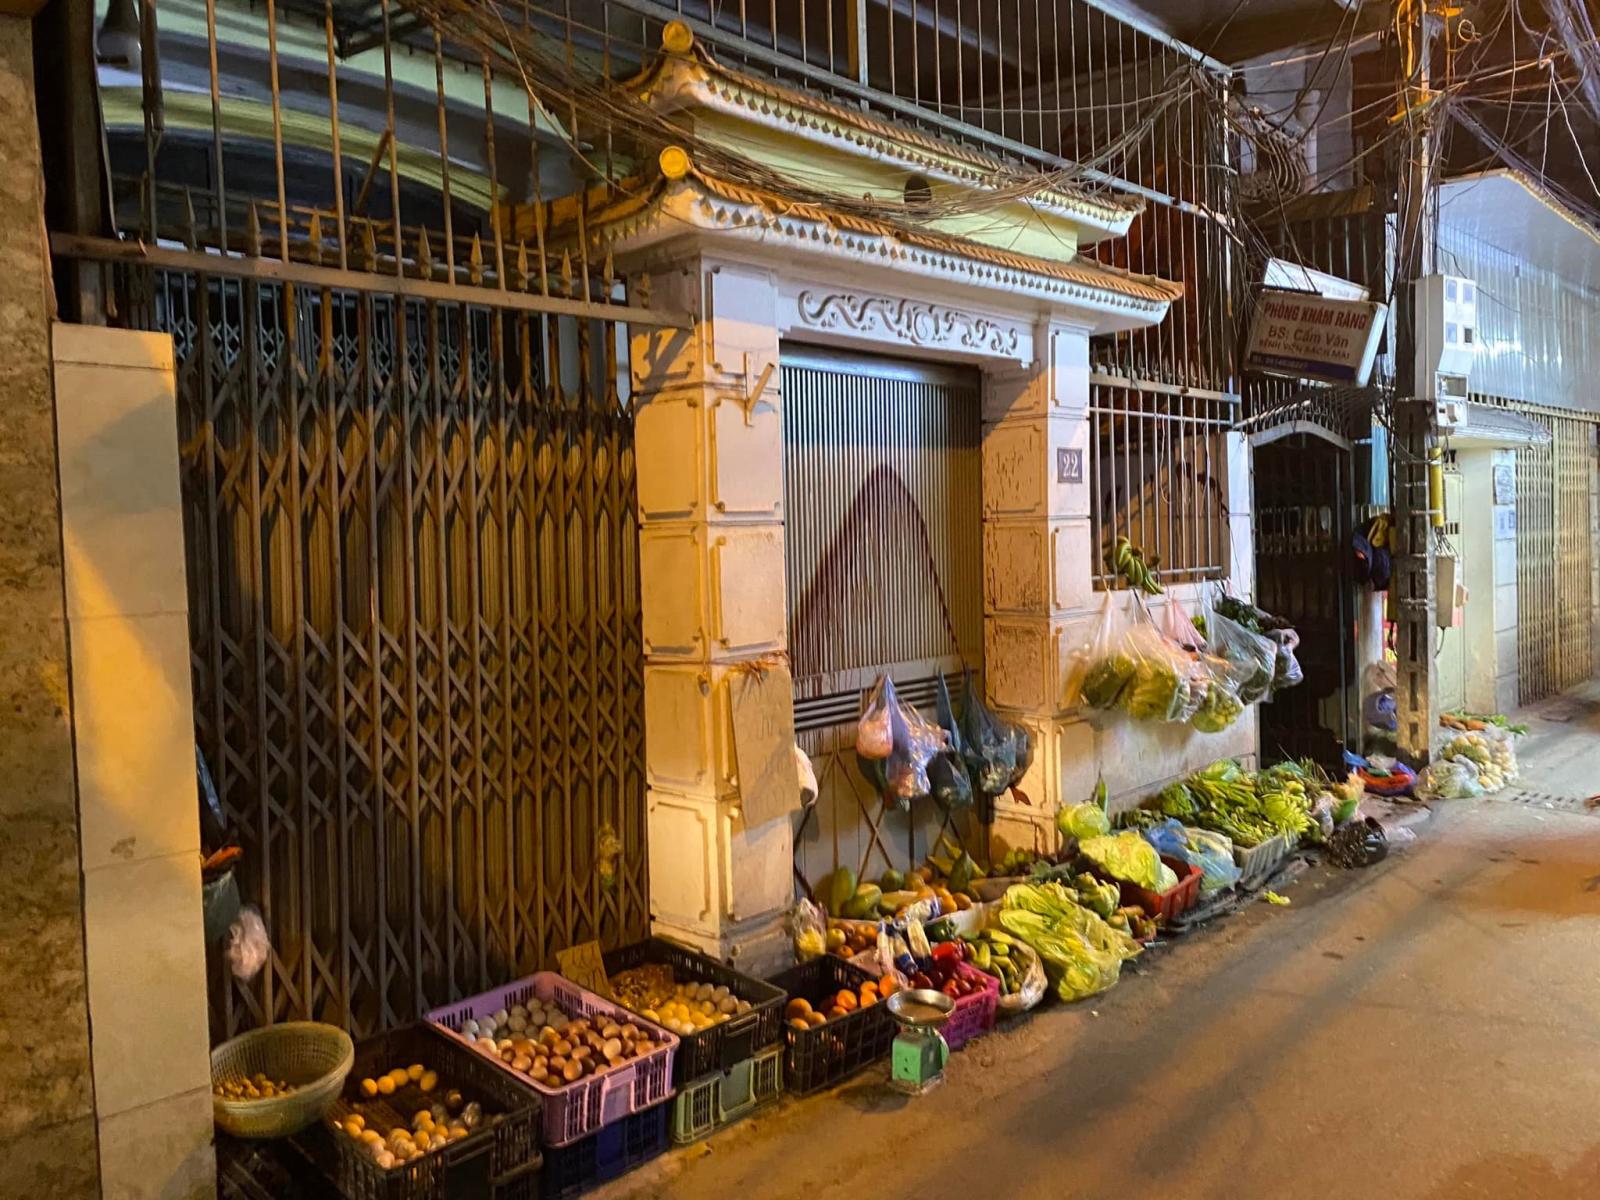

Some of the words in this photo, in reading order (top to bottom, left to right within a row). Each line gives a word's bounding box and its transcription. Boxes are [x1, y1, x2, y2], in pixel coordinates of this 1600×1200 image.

[1264, 301, 1300, 321] PHÒNG
[1301, 306, 1334, 327] KHÁM
[1063, 453, 1079, 477] 22
